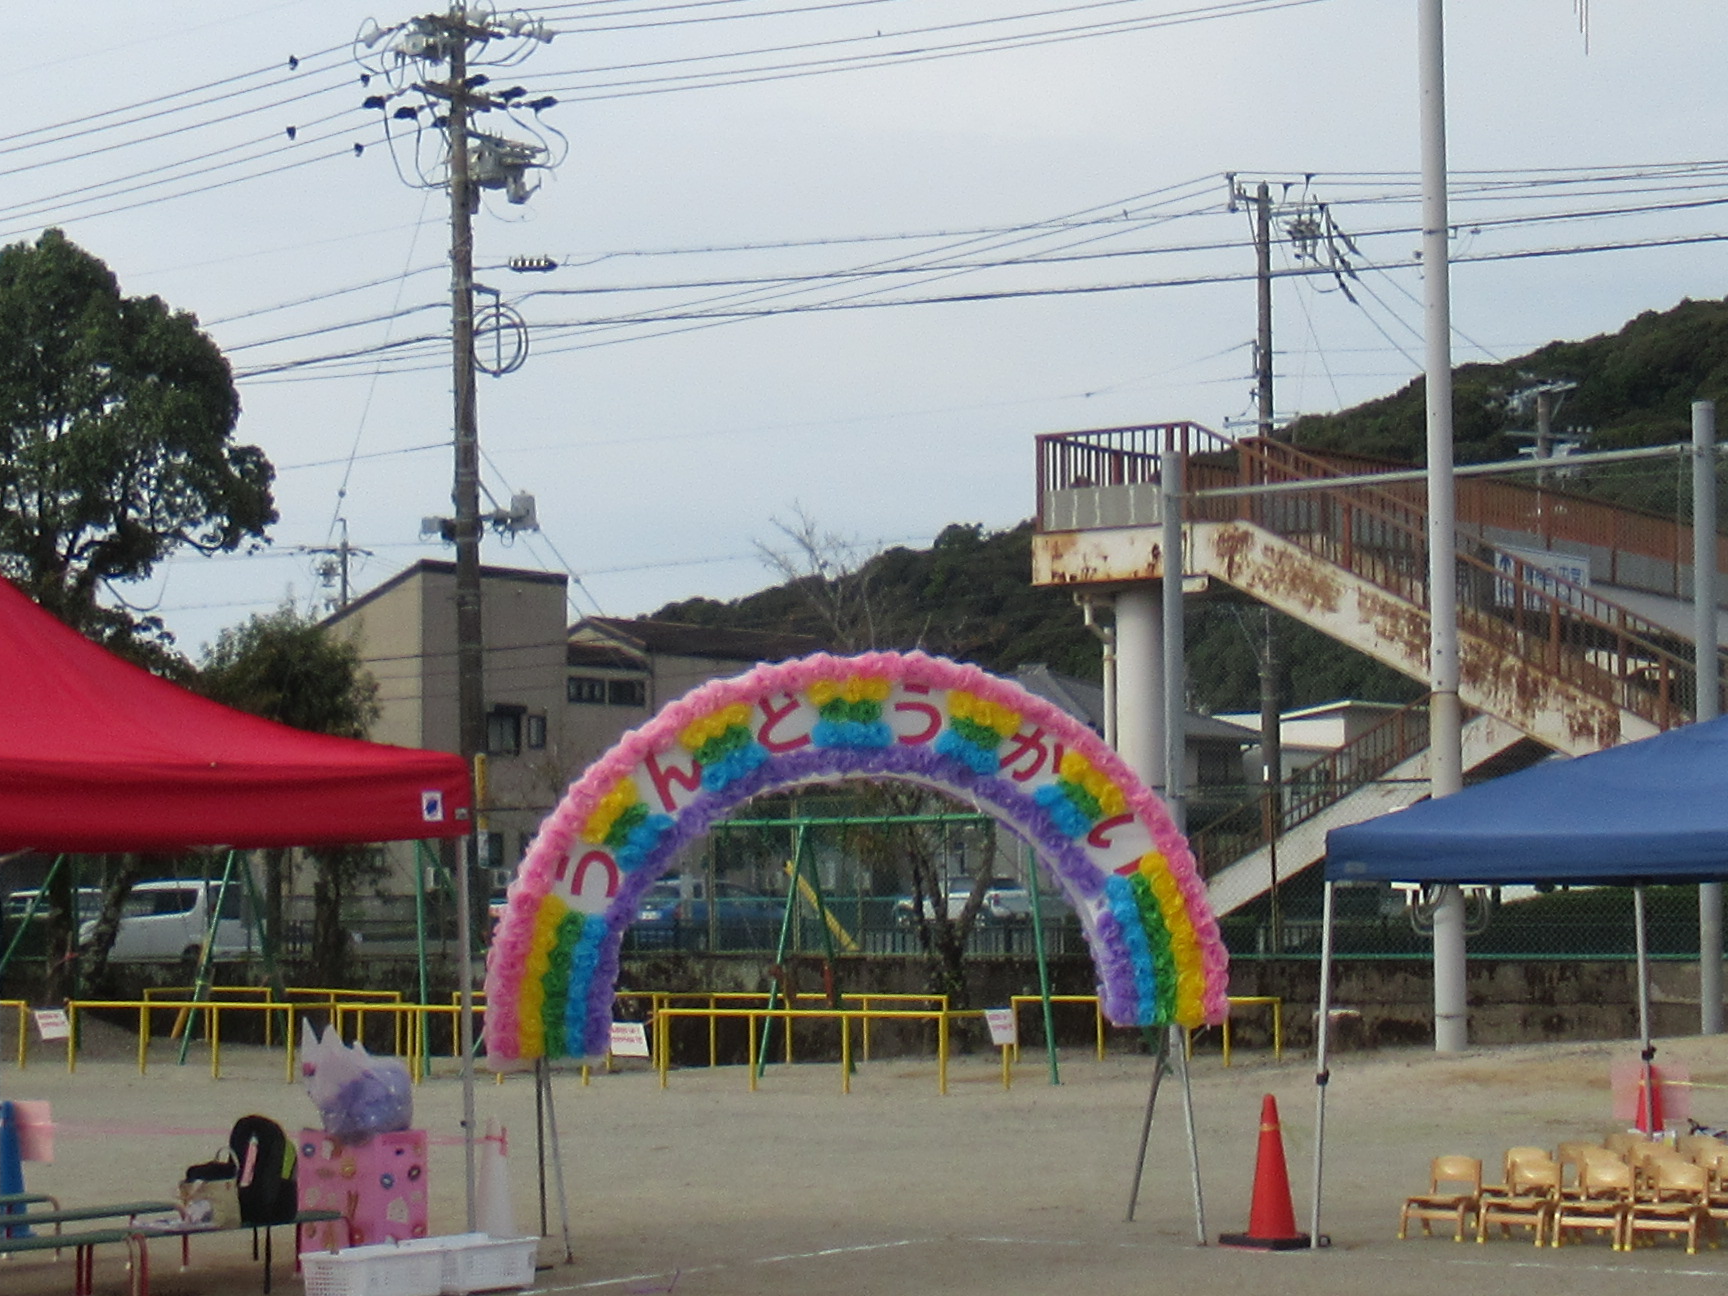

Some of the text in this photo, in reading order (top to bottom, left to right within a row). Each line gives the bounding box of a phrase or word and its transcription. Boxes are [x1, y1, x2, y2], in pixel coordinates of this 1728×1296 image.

[555, 683, 1143, 898] うんどうかい
